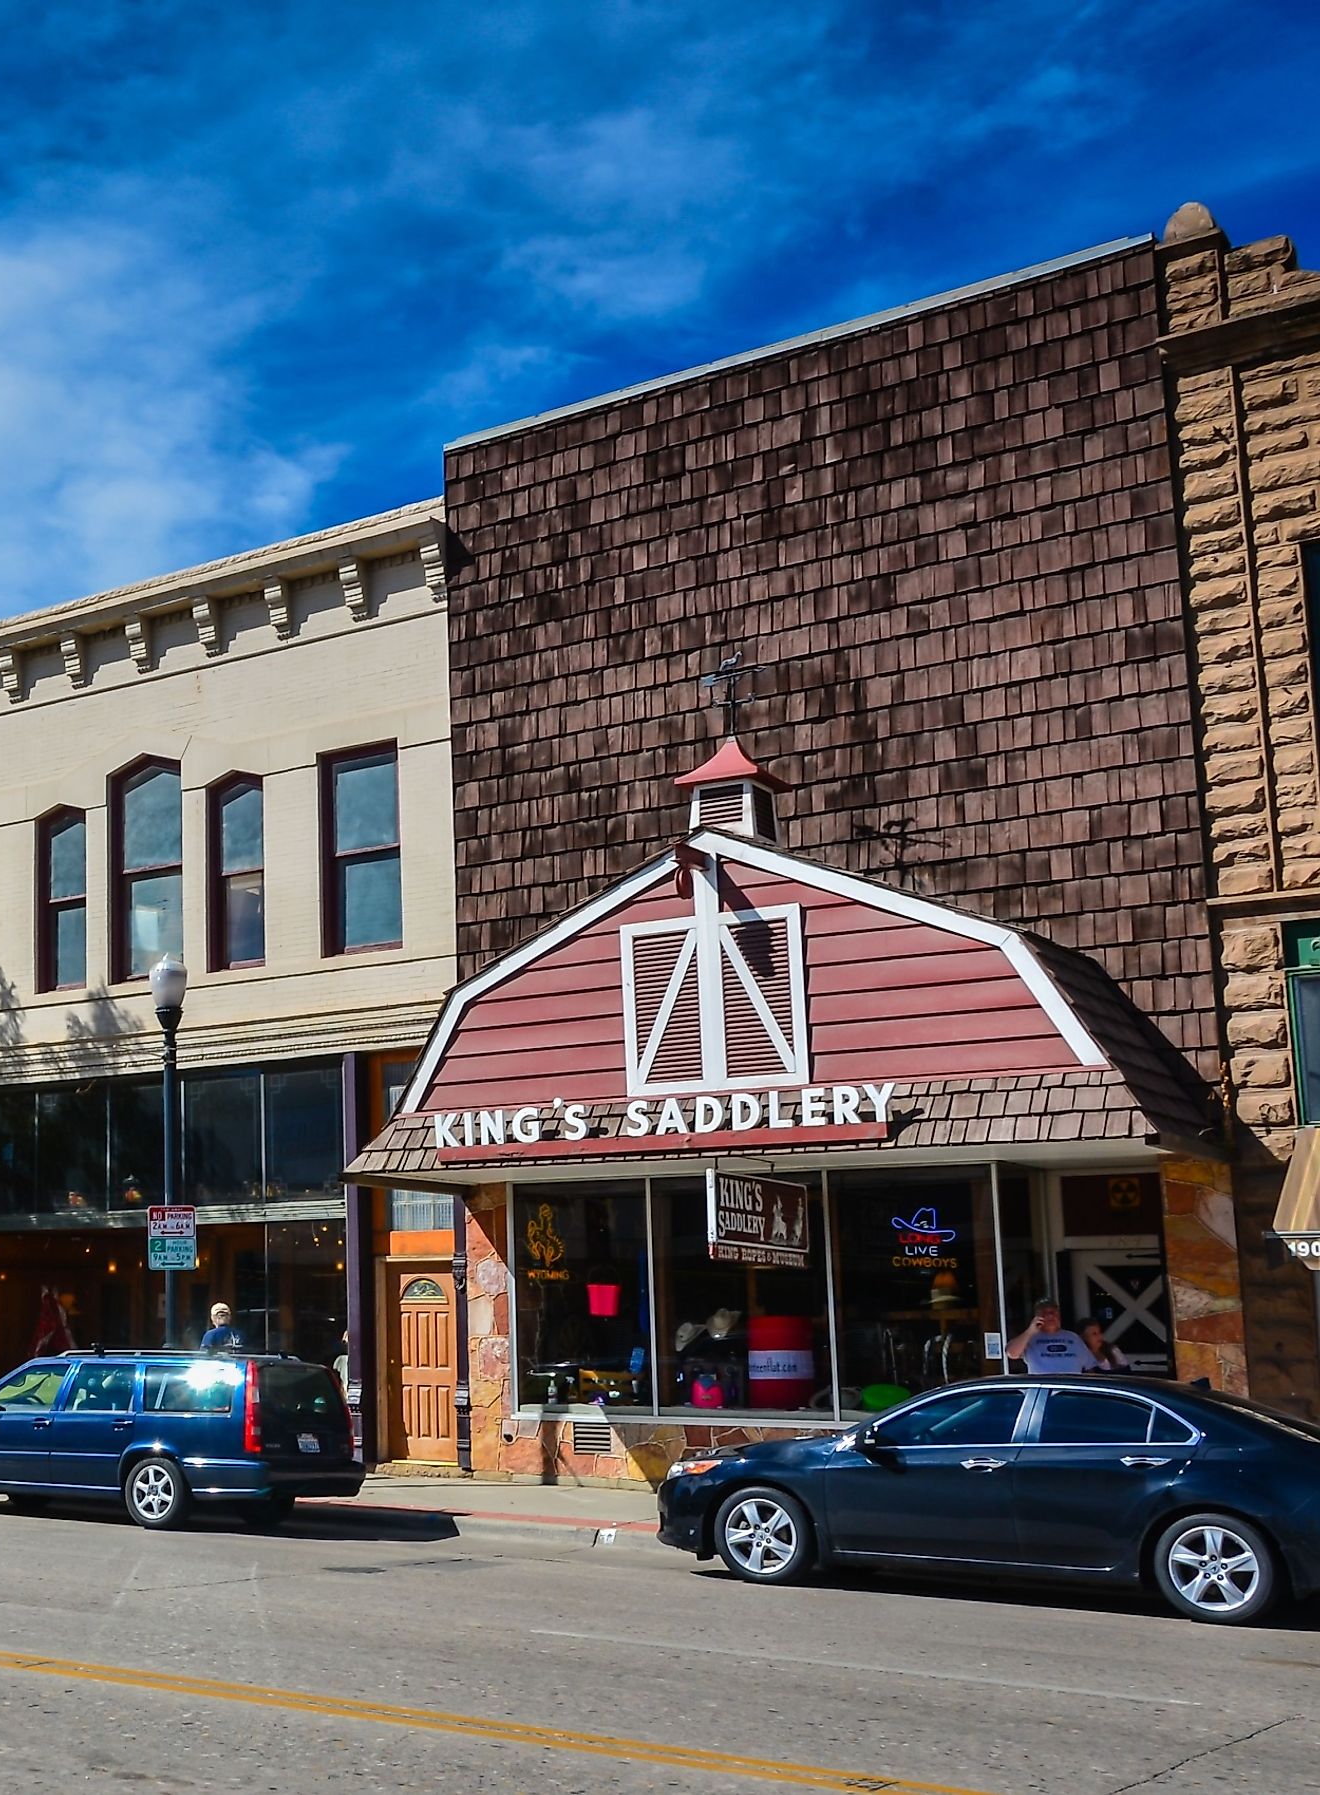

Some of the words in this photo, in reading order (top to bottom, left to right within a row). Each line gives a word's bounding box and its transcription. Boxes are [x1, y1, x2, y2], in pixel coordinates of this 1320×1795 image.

[434, 1097, 586, 1149] KING'S
[627, 1082, 896, 1137] SADDLERY
[719, 1177, 763, 1212] KING'S
[152, 1211, 163, 1220] NO
[167, 1212, 193, 1220] PARKING
[718, 1210, 766, 1241] SADDLERY
[897, 1232, 941, 1245] LONG
[154, 1240, 162, 1251] 2
[167, 1245, 193, 1253] PARKING
[717, 1244, 739, 1260] KING
[905, 1245, 939, 1257] LIVE
[892, 1256, 958, 1269] COWBOYS
